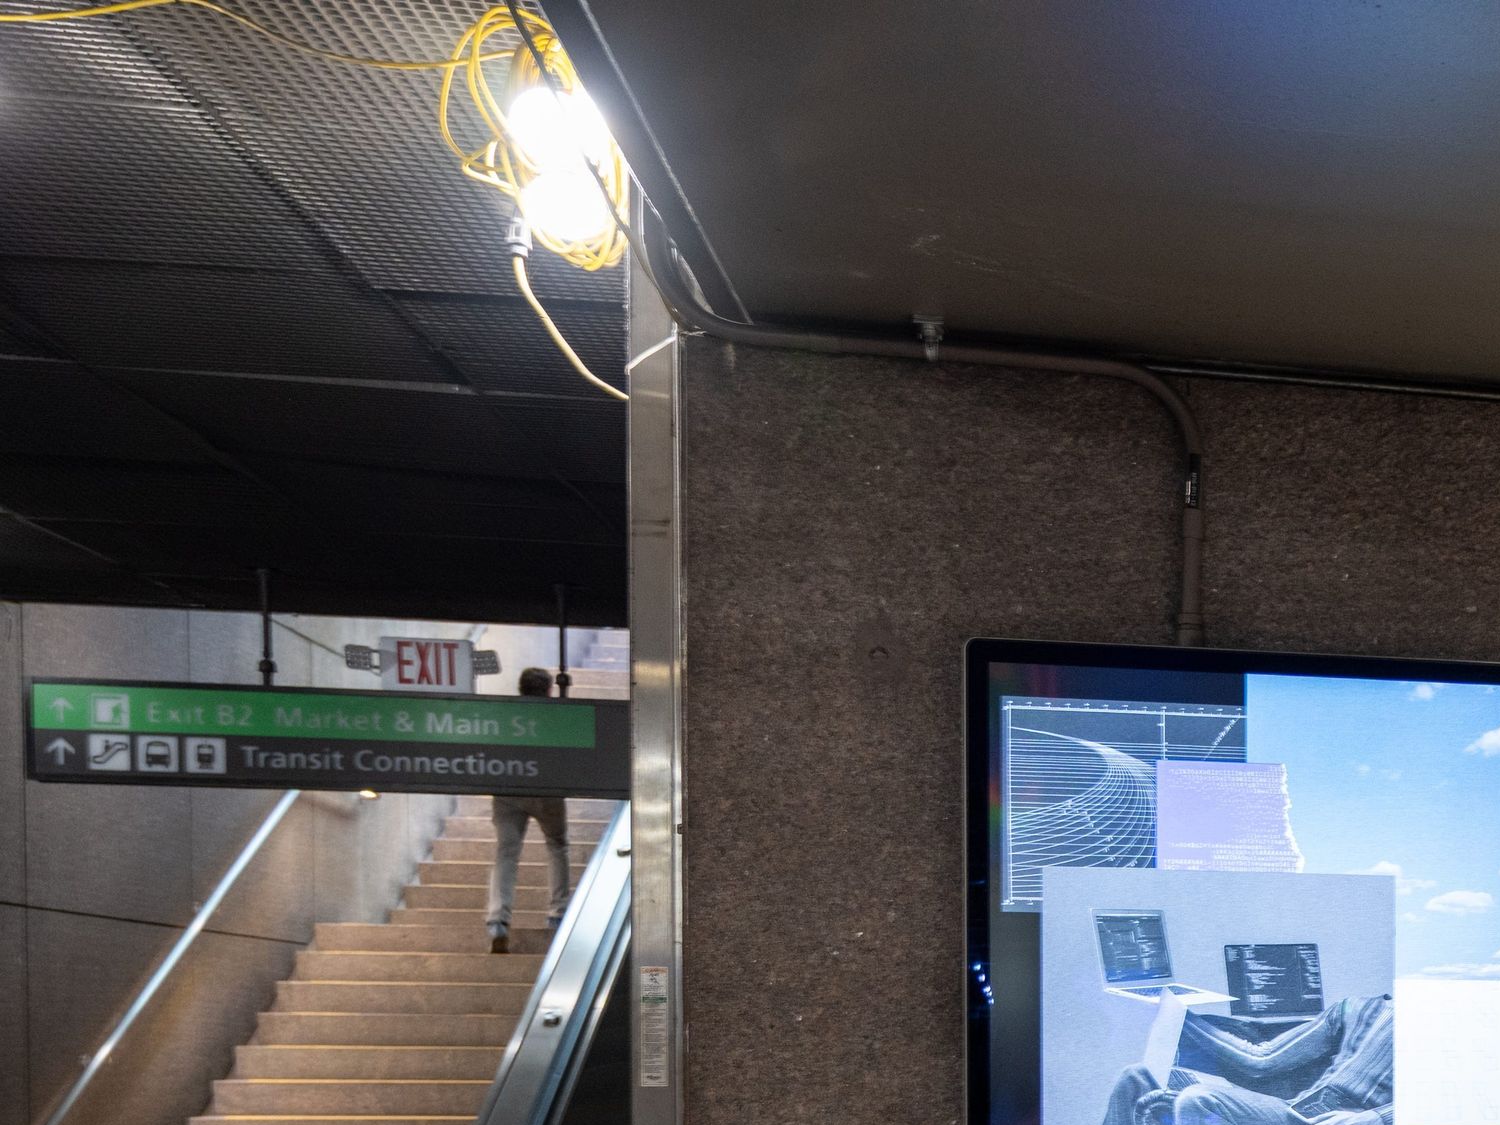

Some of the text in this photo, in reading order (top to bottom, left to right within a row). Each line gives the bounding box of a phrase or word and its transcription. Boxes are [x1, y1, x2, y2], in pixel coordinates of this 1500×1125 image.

[397, 641, 459, 686] EXIT
[148, 702, 537, 737] Exit B2 Market & Main St
[241, 746, 538, 777] Transit Connections
